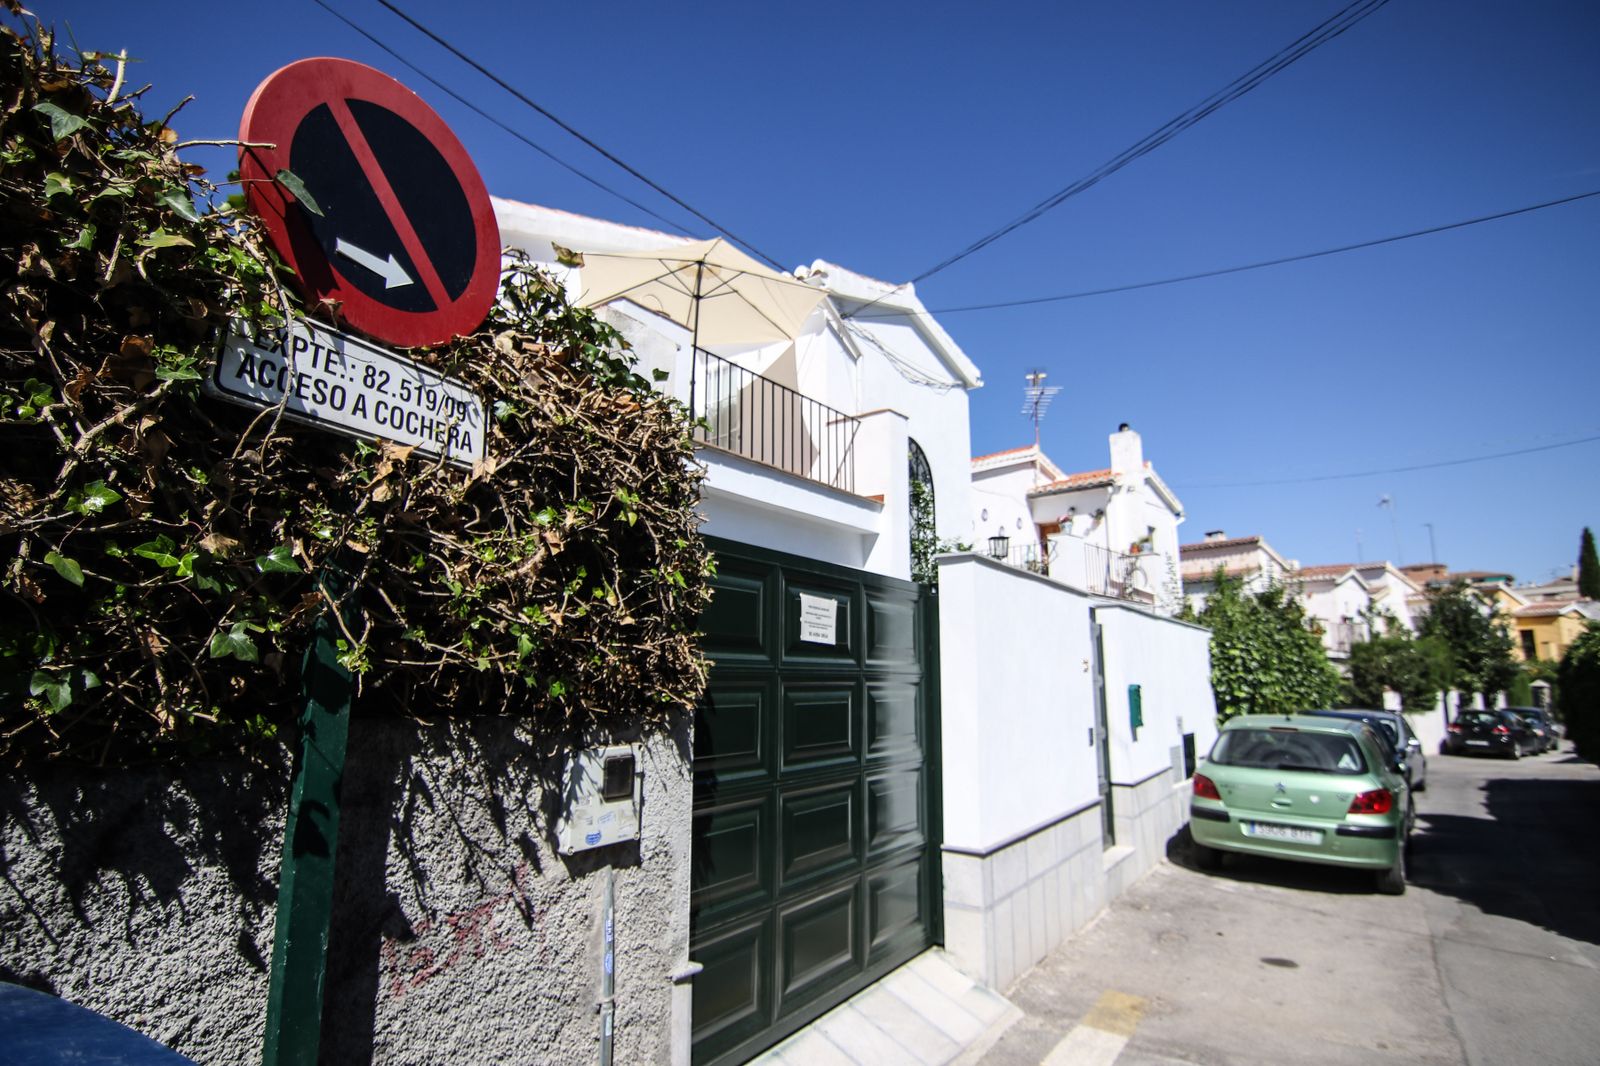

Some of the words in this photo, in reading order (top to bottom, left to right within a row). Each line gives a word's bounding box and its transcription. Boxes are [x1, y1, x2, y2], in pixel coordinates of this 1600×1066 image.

[235, 353, 346, 411] ACCESO
[351, 393, 367, 419] A
[375, 400, 472, 453] COCHERA
[363, 365, 466, 422] 82.519/09
